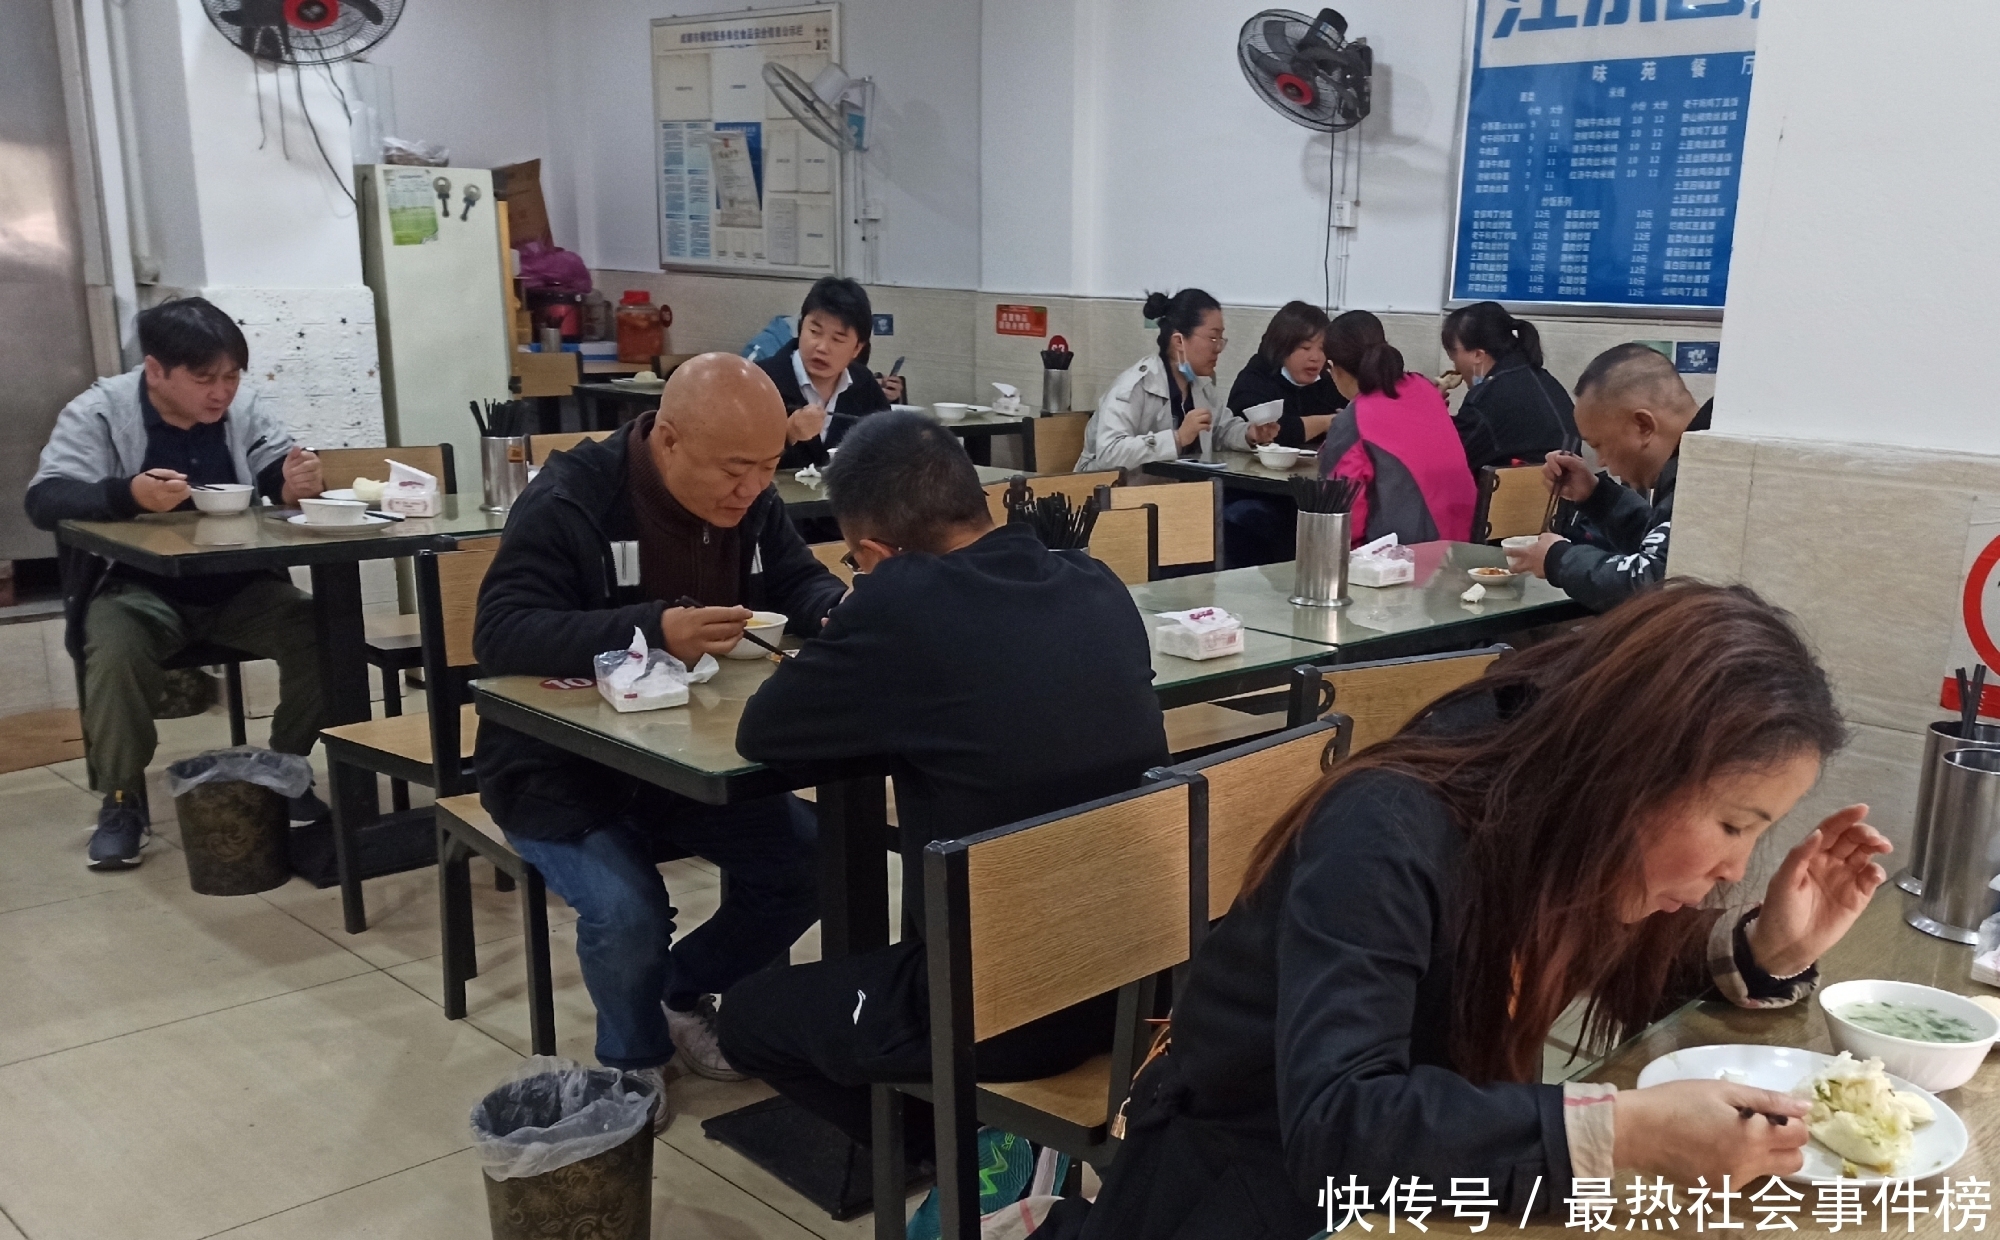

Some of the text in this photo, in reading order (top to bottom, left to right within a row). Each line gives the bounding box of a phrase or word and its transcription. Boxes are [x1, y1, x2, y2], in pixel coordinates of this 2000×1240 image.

[1549, 105, 1563, 114] 大份
[1652, 100, 1669, 110] 大份
[1654, 115, 1665, 123] 12
[1530, 120, 1536, 128] 9
[1652, 128, 1664, 137] 12
[1528, 146, 1534, 154] 9
[1651, 141, 1661, 150] 12
[1526, 158, 1532, 167] 9
[1649, 155, 1660, 163] 12
[1525, 171, 1531, 179] 9
[1648, 168, 1659, 177] 12
[1524, 184, 1530, 192] 9
[545, 677, 593, 689] 10
